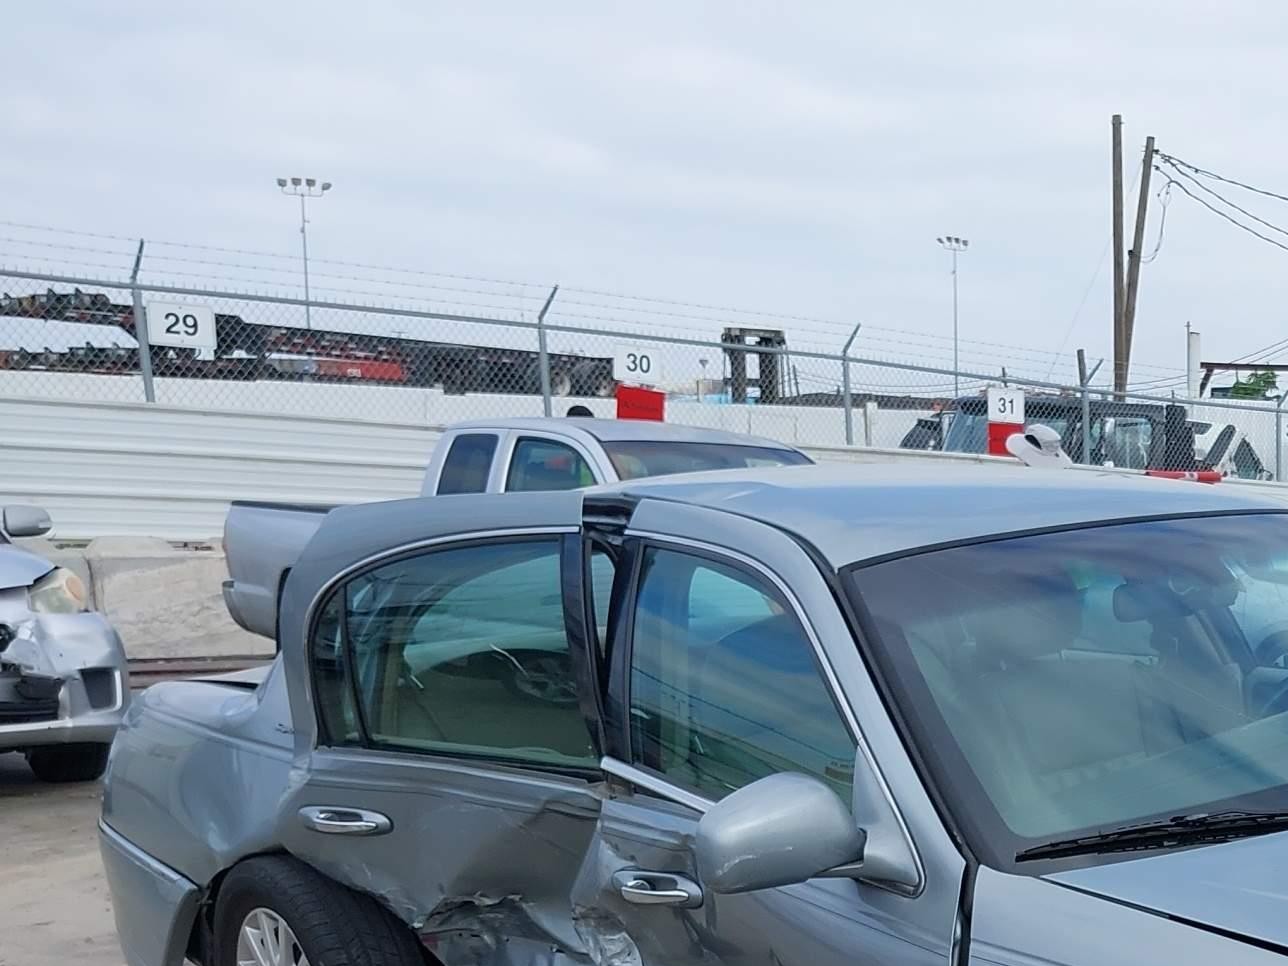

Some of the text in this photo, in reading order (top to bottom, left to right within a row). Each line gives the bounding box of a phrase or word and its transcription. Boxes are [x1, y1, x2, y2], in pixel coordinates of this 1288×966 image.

[165, 312, 199, 337] 29
[626, 353, 651, 374] 30
[998, 397, 1015, 415] 31
